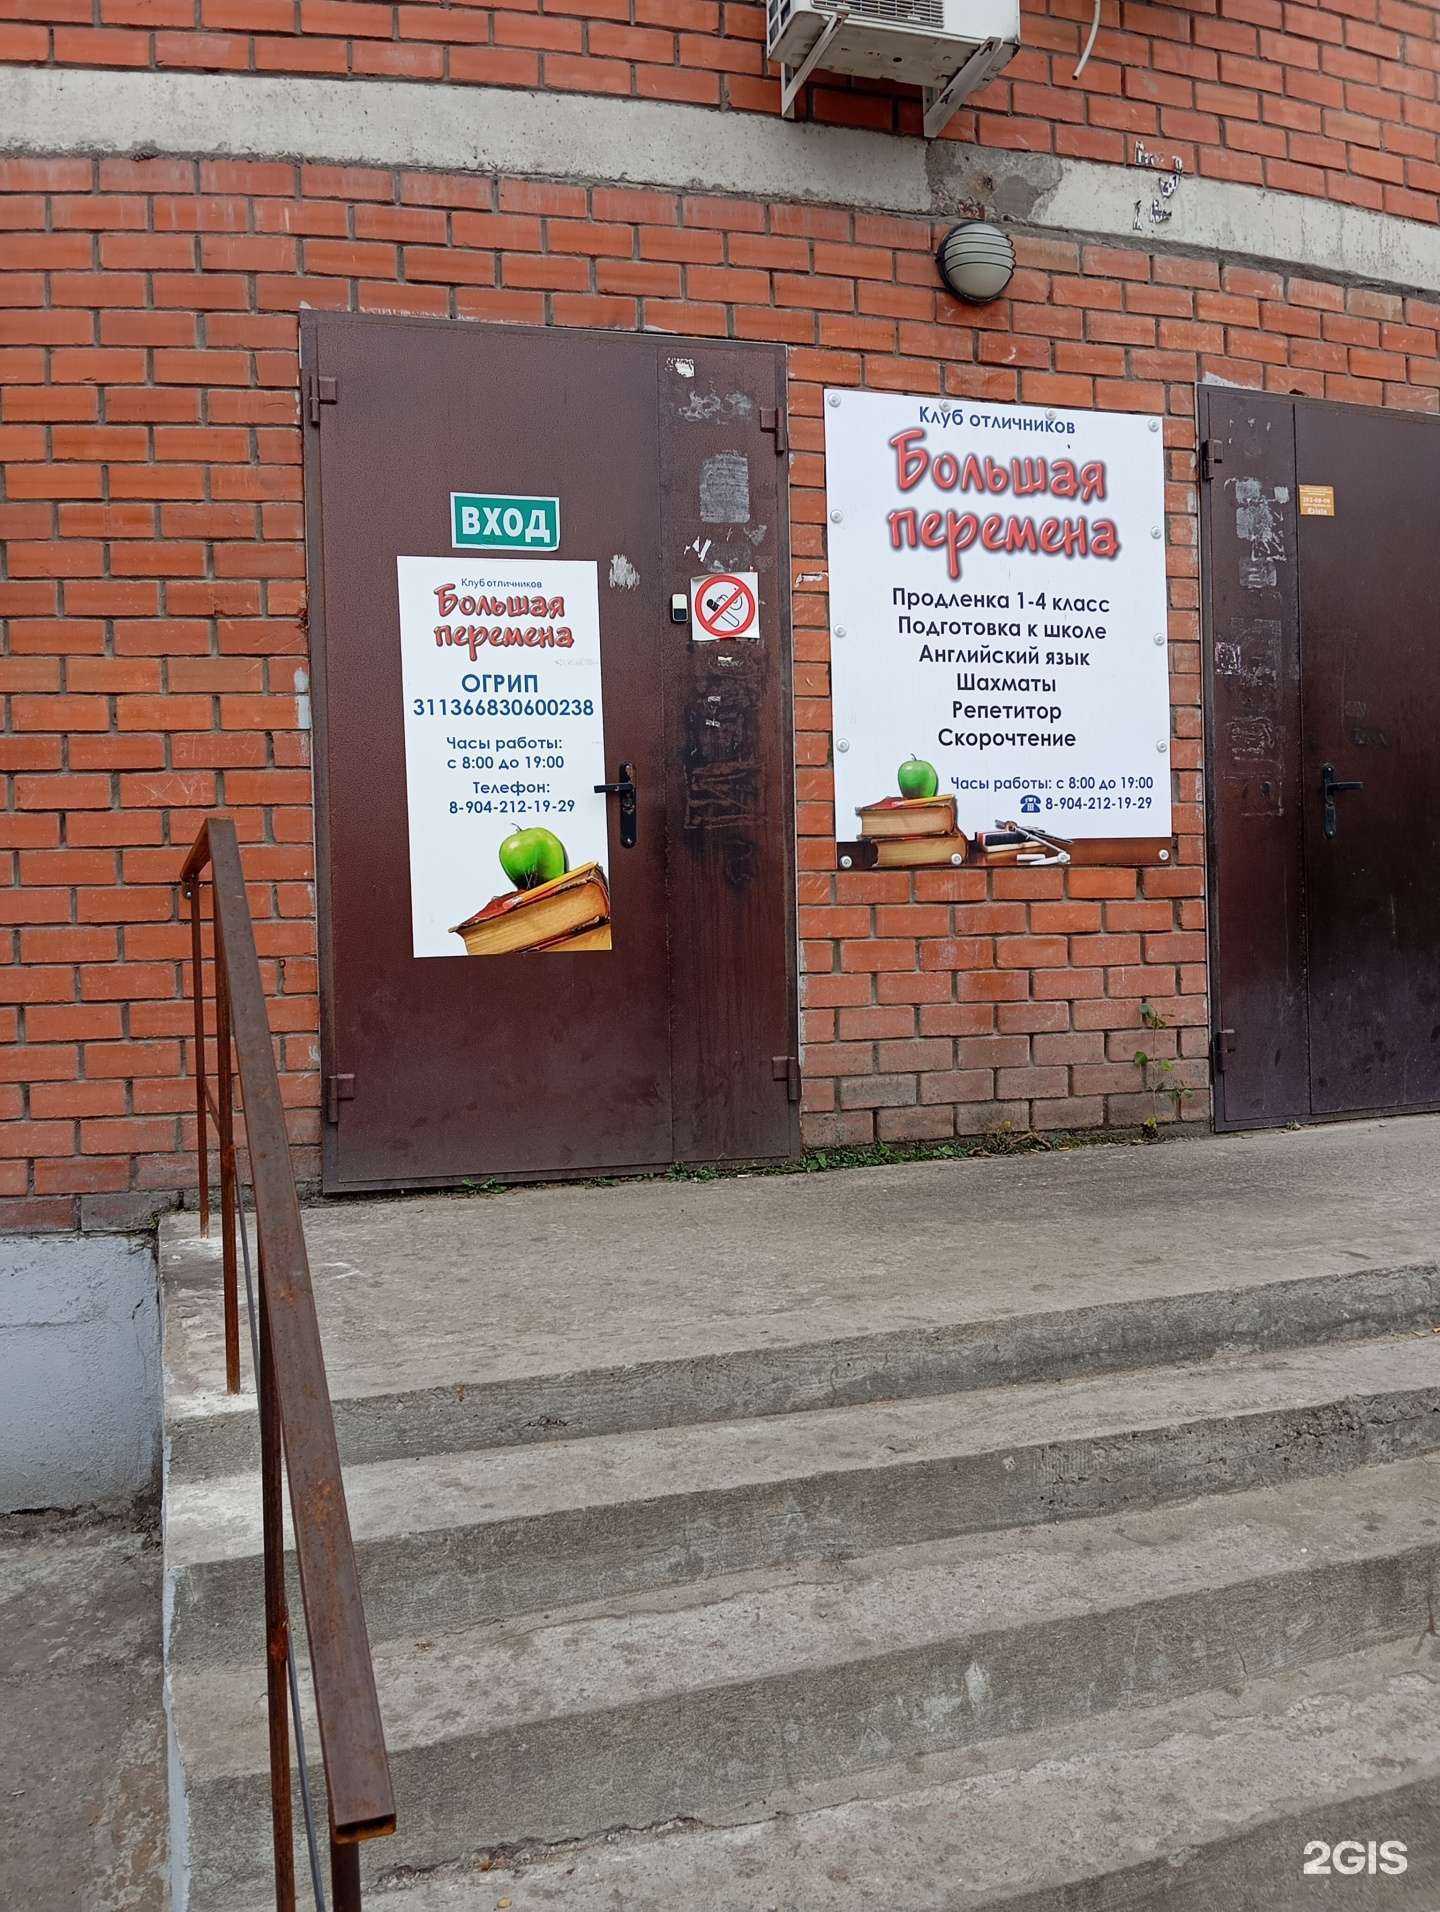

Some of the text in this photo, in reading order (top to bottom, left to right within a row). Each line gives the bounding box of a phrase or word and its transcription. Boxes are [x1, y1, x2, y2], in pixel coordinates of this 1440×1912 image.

[919, 405, 1075, 434] Клуб отличников
[888, 427, 1108, 504] Большая
[461, 506, 550, 543] ВХОД
[888, 507, 1122, 581] перемена
[461, 577, 543, 590] Клуб отличников
[433, 583, 565, 619] Большая
[892, 587, 1110, 613] Продленка 1-4 класс
[898, 616, 1107, 640] Подготовка к школе
[433, 625, 575, 662] перемена
[918, 644, 1091, 667] Английский язык
[461, 674, 538, 693] ОГРИП
[956, 673, 1057, 692] Шахматы
[413, 698, 594, 716] 311366830600238
[952, 701, 1062, 723] Репетитор
[446, 736, 562, 753] Часы работы:
[938, 728, 1076, 750] Скорочтение
[446, 755, 565, 771] с 8:00 до 19:00
[472, 780, 551, 797] Телефон:
[950, 776, 1154, 793] Часы работы: с 8:00 до 19:00
[449, 799, 576, 815] 8-904-212-19-29
[1044, 796, 1153, 812] 8-904-212-19-29
